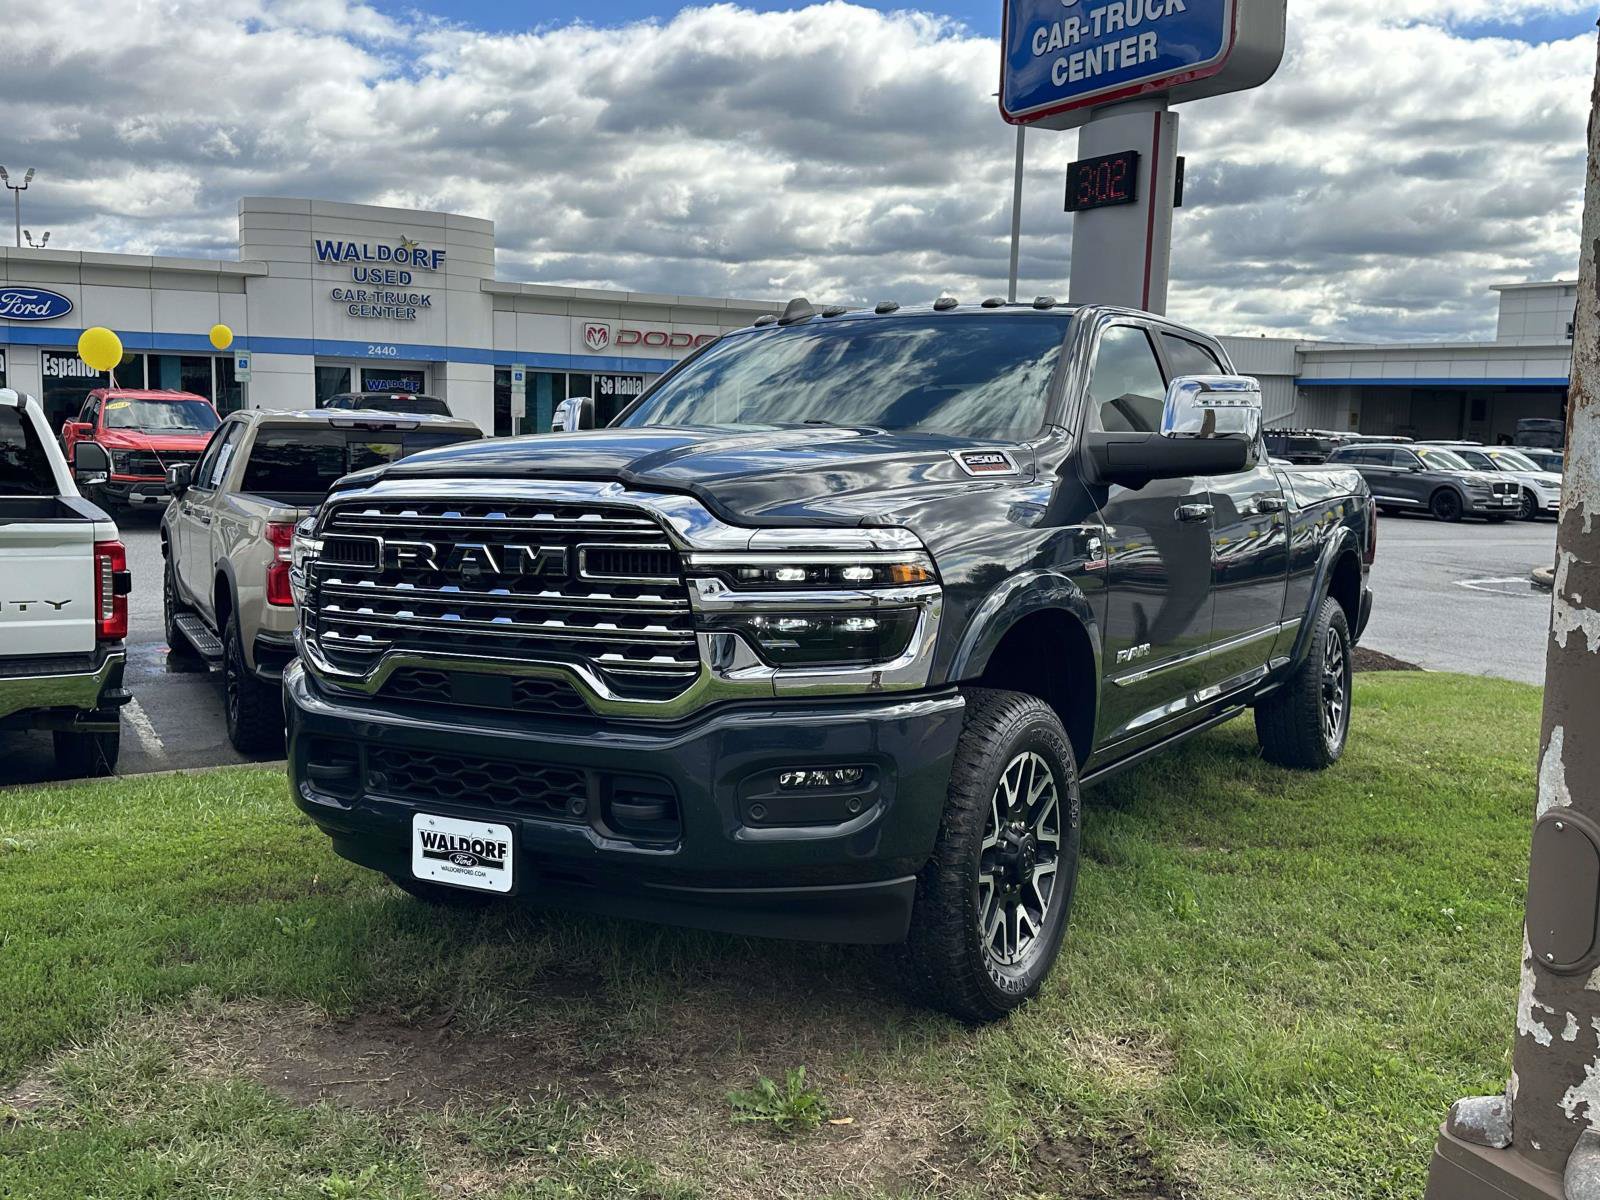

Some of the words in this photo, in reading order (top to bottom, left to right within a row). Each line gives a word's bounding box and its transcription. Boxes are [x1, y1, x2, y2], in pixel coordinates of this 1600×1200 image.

[1031, 0, 1187, 56] CAR-TRUCK
[1051, 31, 1158, 87] CENTER
[1077, 159, 1127, 203] 3:02
[314, 239, 447, 271] WALDORF
[353, 266, 413, 286] USED
[0, 292, 51, 316] Ford
[331, 287, 432, 308] CAR-TRUCK
[348, 304, 417, 320] CENTER
[616, 329, 718, 348] DODG
[368, 345, 397, 357] 2440
[366, 378, 420, 393] WALDORF
[614, 376, 642, 395] Habla
[965, 455, 1004, 464] 2500
[384, 539, 569, 576] RAM
[0, 599, 73, 612] TY
[419, 830, 508, 861] WALDORF
